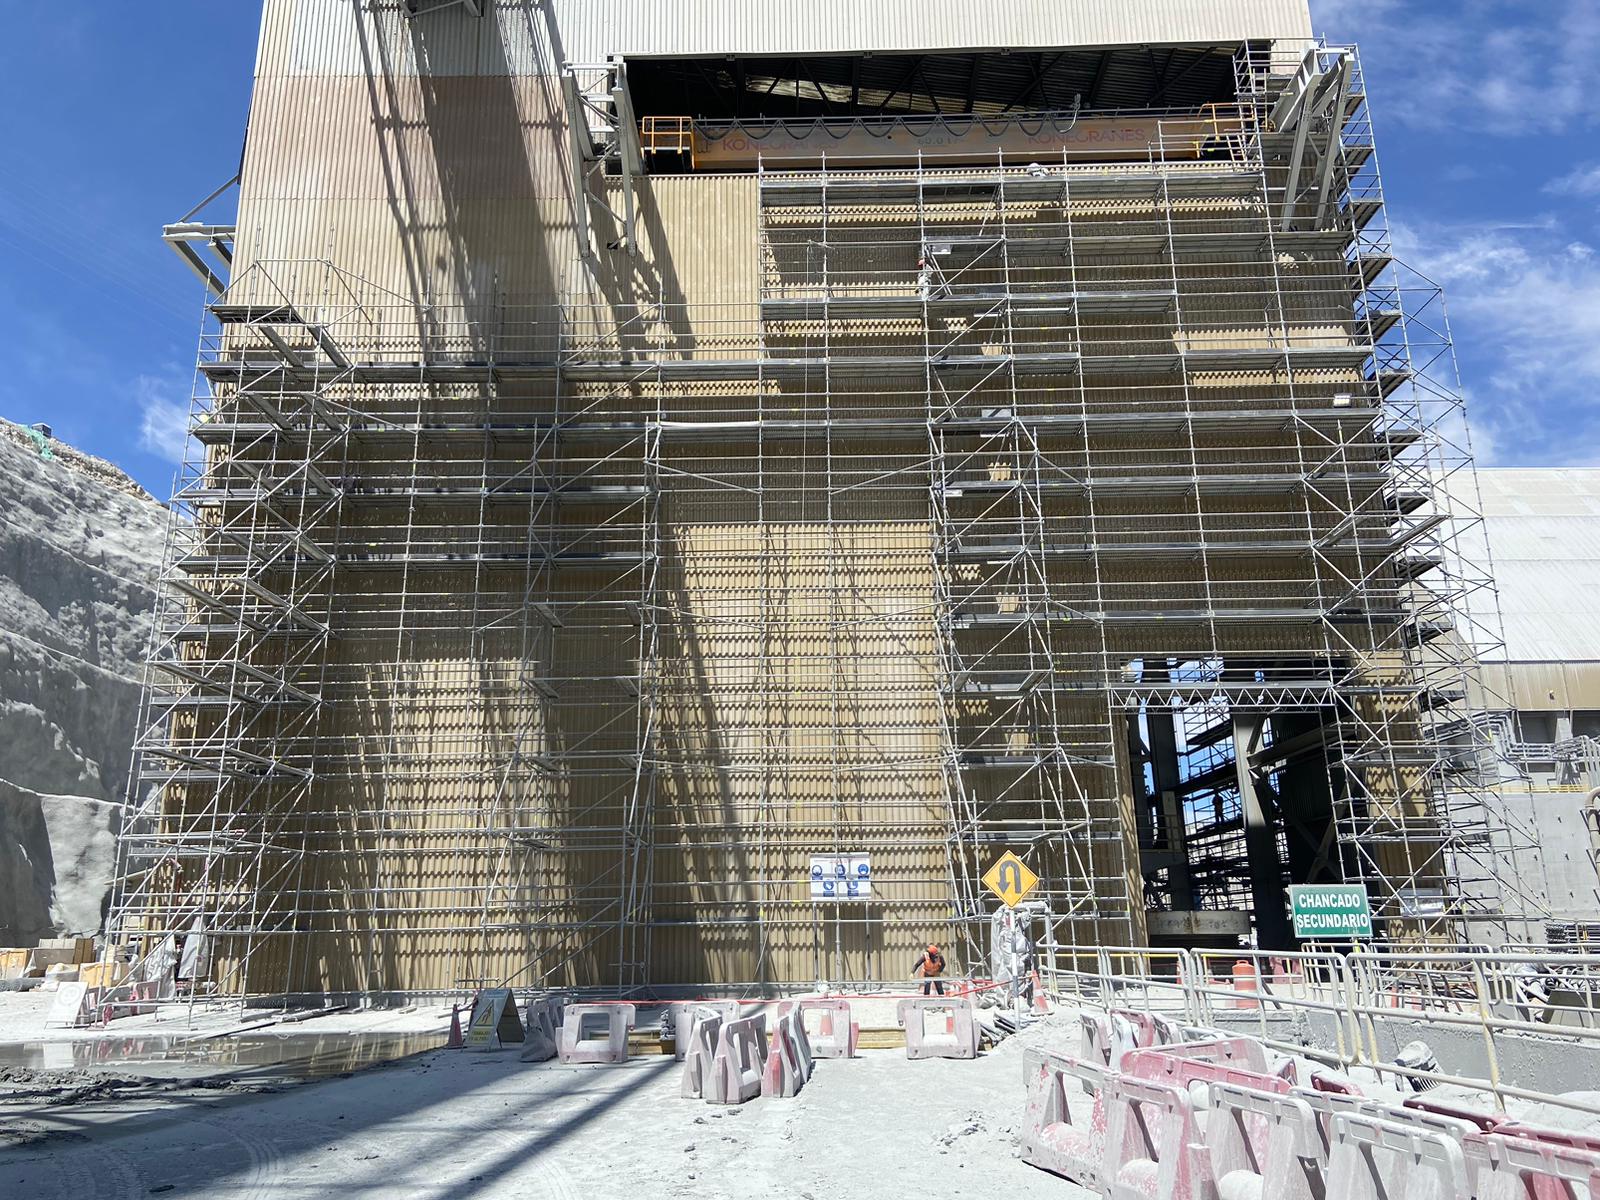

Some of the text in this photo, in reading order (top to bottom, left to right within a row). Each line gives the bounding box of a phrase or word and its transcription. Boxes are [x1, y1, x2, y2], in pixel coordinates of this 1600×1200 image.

[1028, 128, 1146, 145] KONECRANES
[1298, 893, 1360, 908] CHANCADO
[1296, 913, 1369, 928] SECUNDARIO
